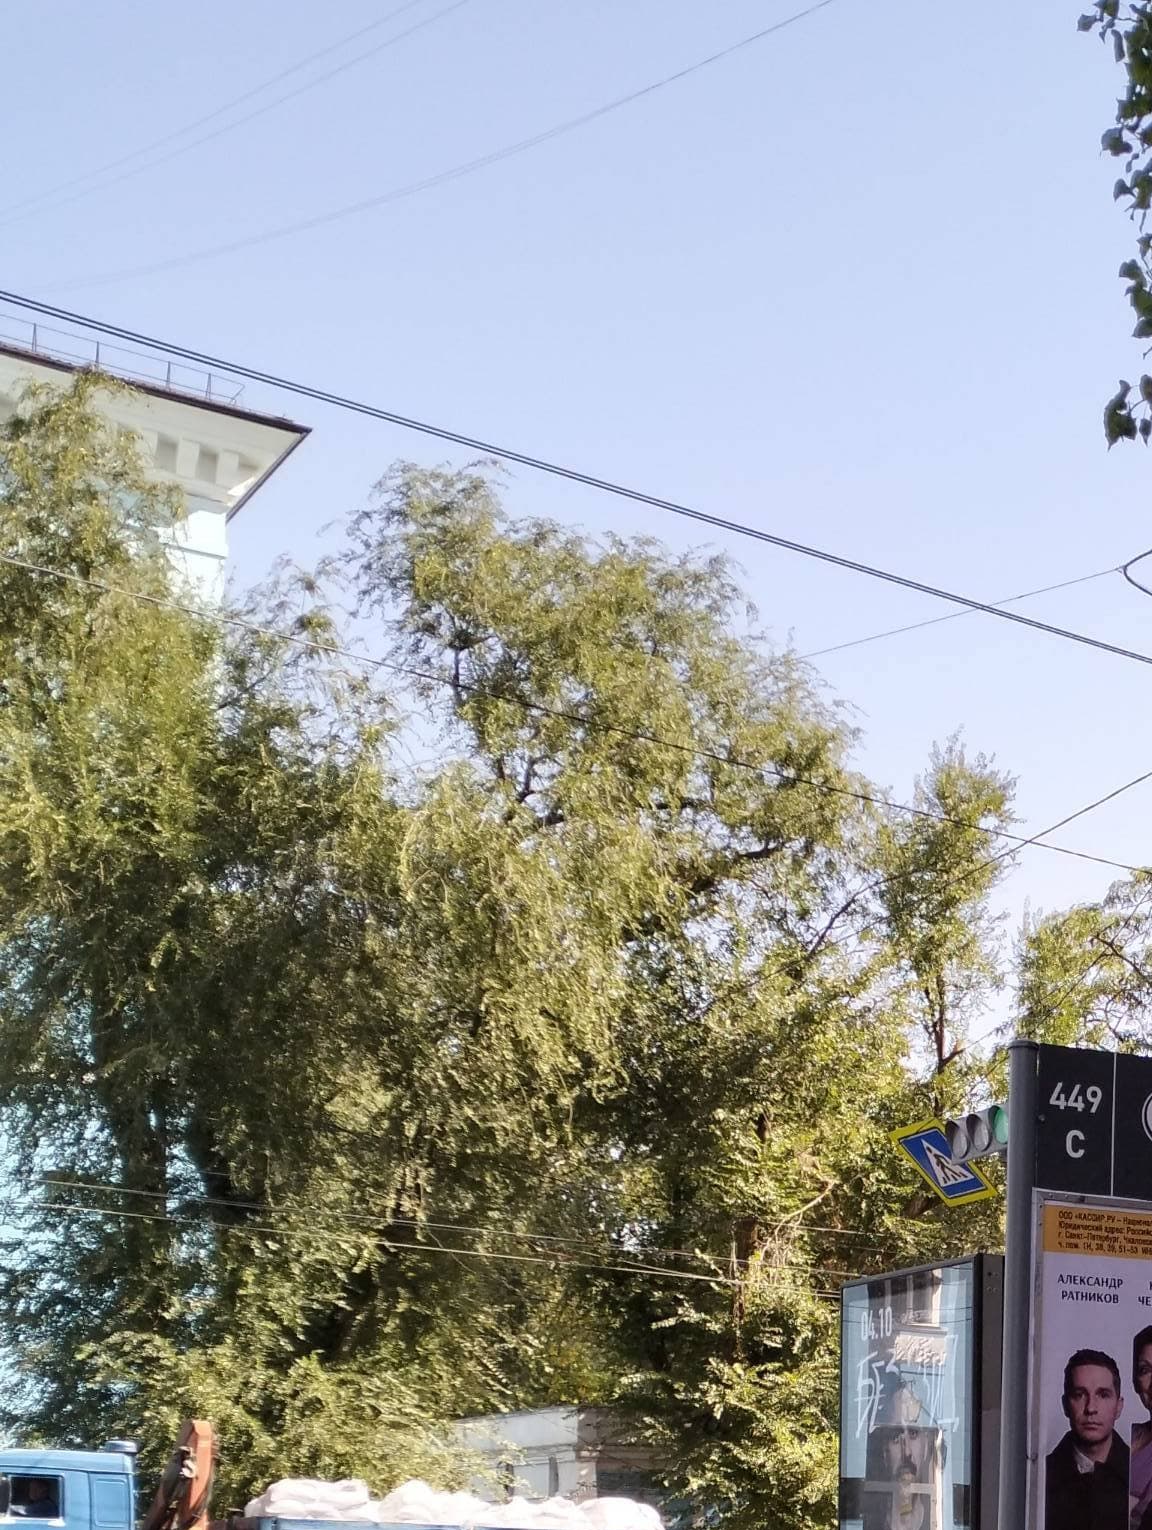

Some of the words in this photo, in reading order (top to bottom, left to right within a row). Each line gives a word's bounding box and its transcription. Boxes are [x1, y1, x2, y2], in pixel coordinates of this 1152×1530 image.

[1049, 1081, 1103, 1114] 449
[1057, 1273, 1124, 1289] АЛЕКСАНДР
[1061, 1290, 1119, 1304] РАТНИКОВ
[861, 1306, 893, 1341] 04.10
